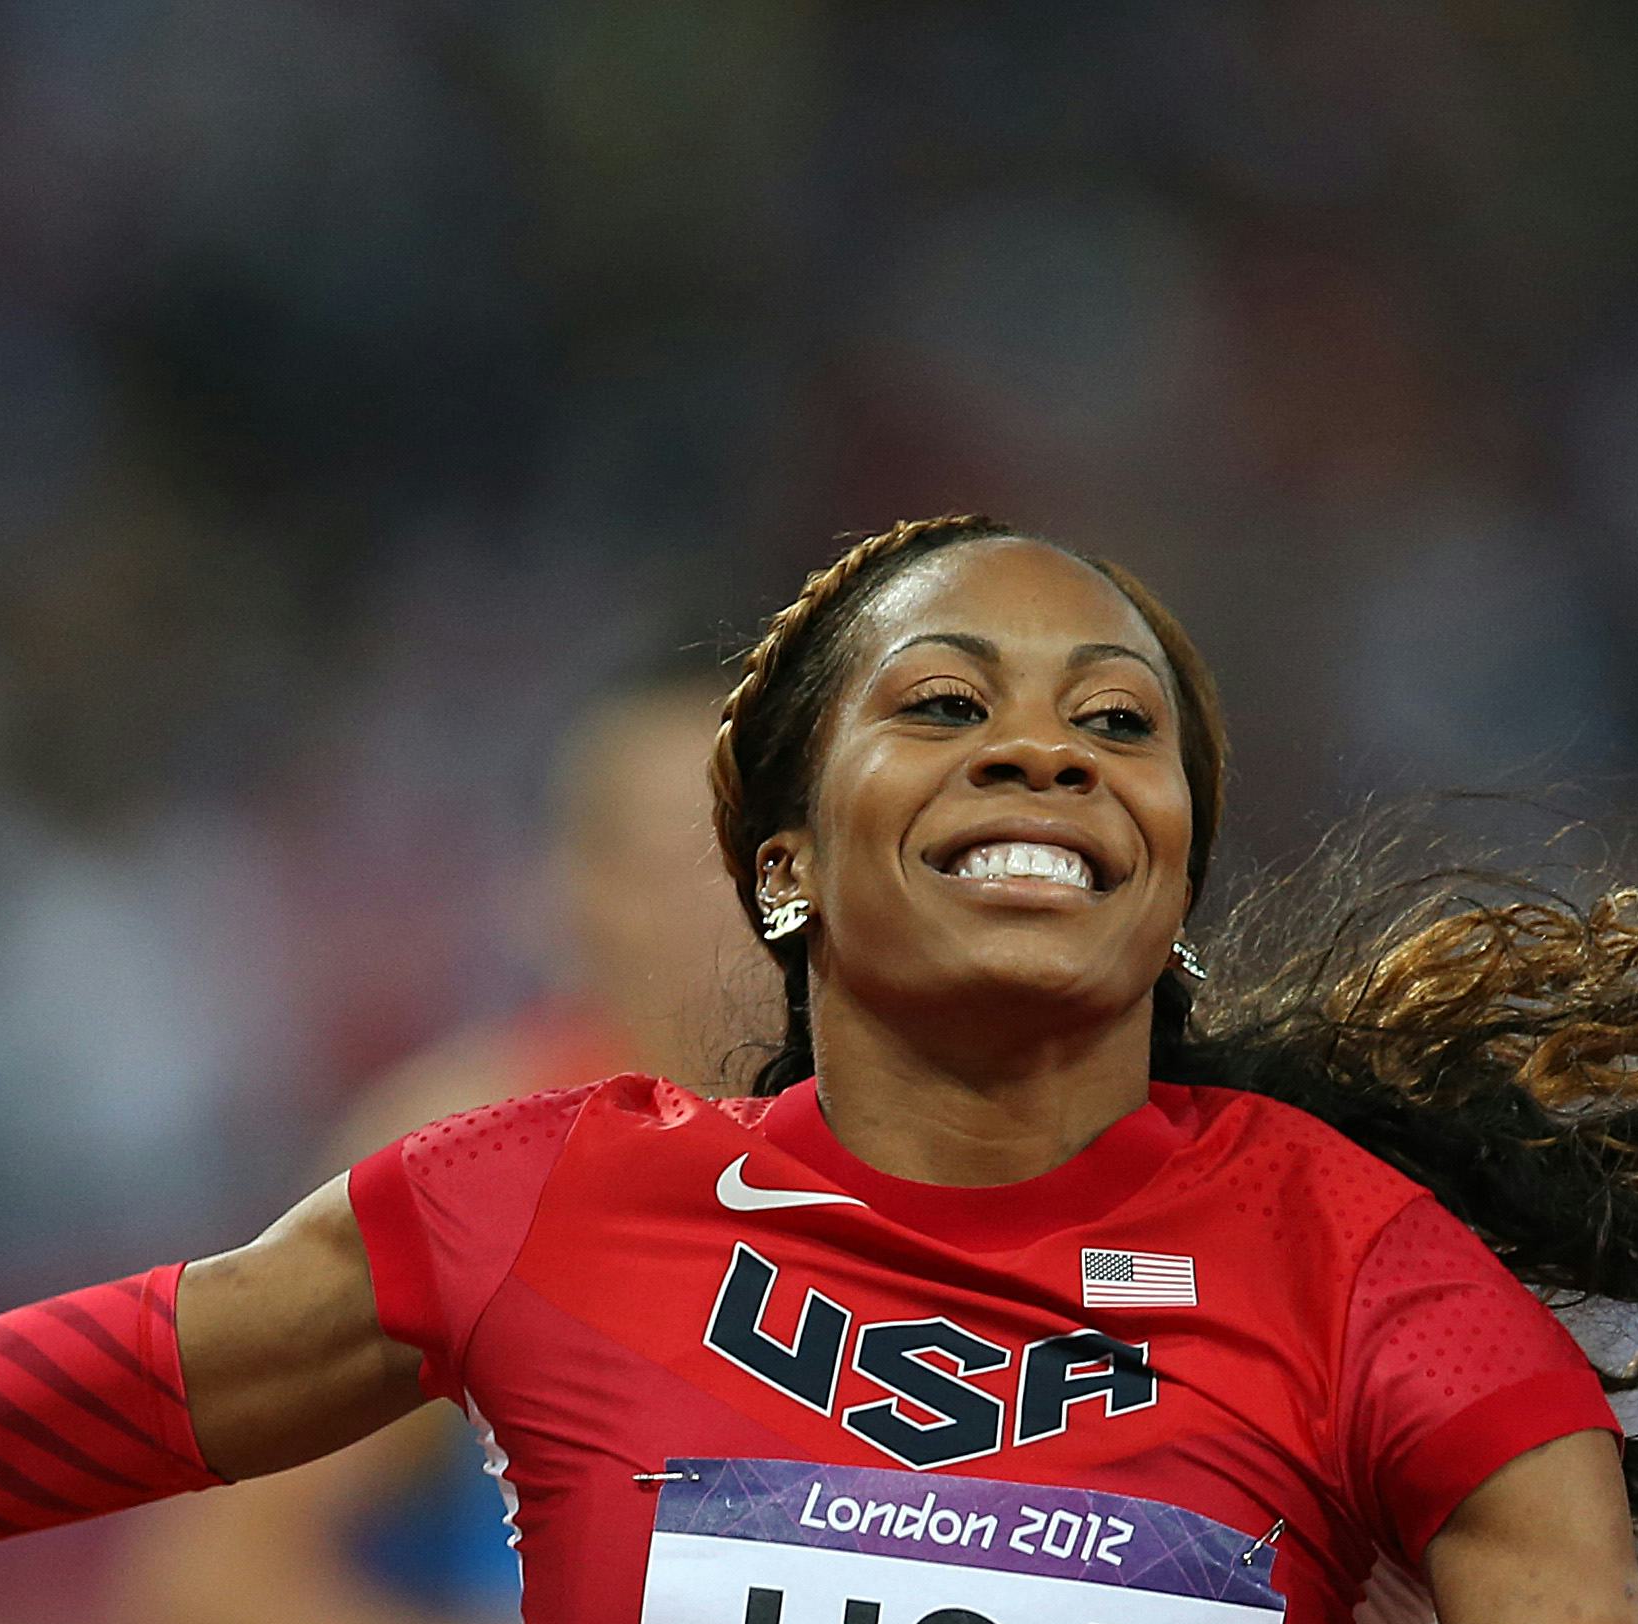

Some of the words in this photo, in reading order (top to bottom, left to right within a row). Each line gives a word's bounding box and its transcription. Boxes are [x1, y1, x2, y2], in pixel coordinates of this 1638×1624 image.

[703, 1240, 1158, 1470] USA
[799, 1481, 999, 1550] London
[1009, 1505, 1135, 1567] 2012
